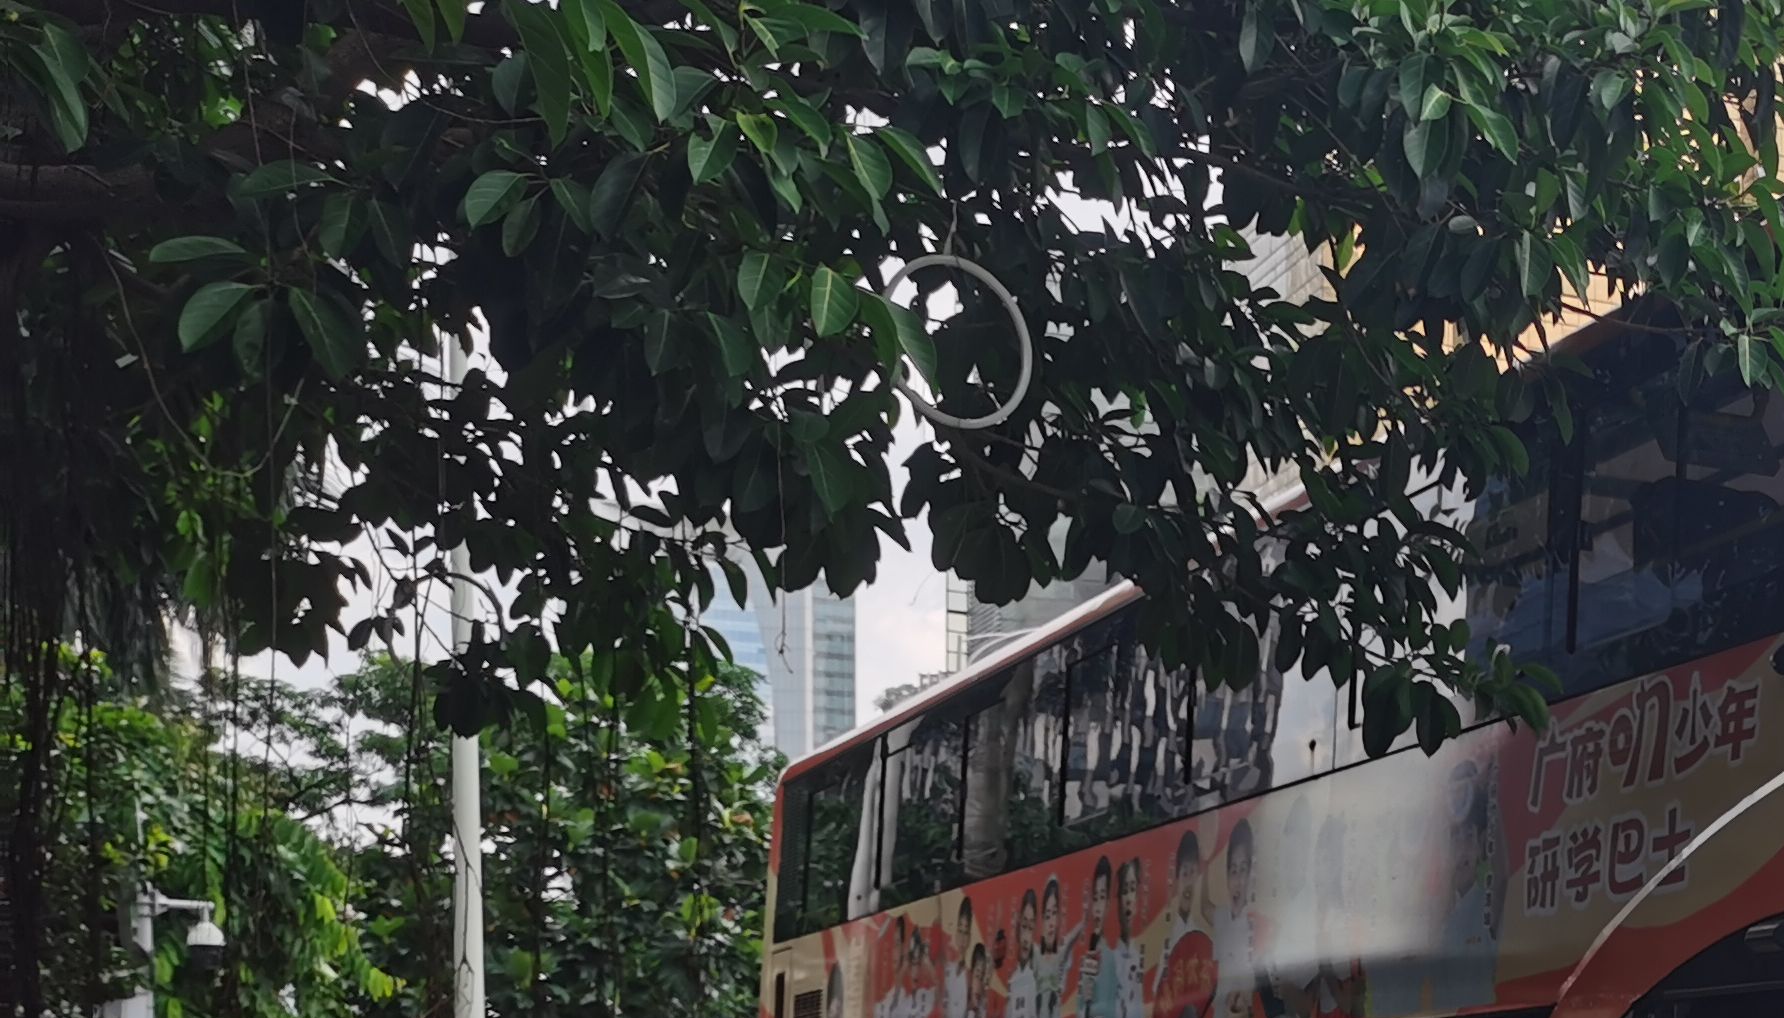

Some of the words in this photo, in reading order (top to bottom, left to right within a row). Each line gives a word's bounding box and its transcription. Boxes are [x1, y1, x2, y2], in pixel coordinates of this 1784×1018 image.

[1528, 672, 1761, 811] 广府叻少年
[1526, 806, 1695, 912] 研学巴士
